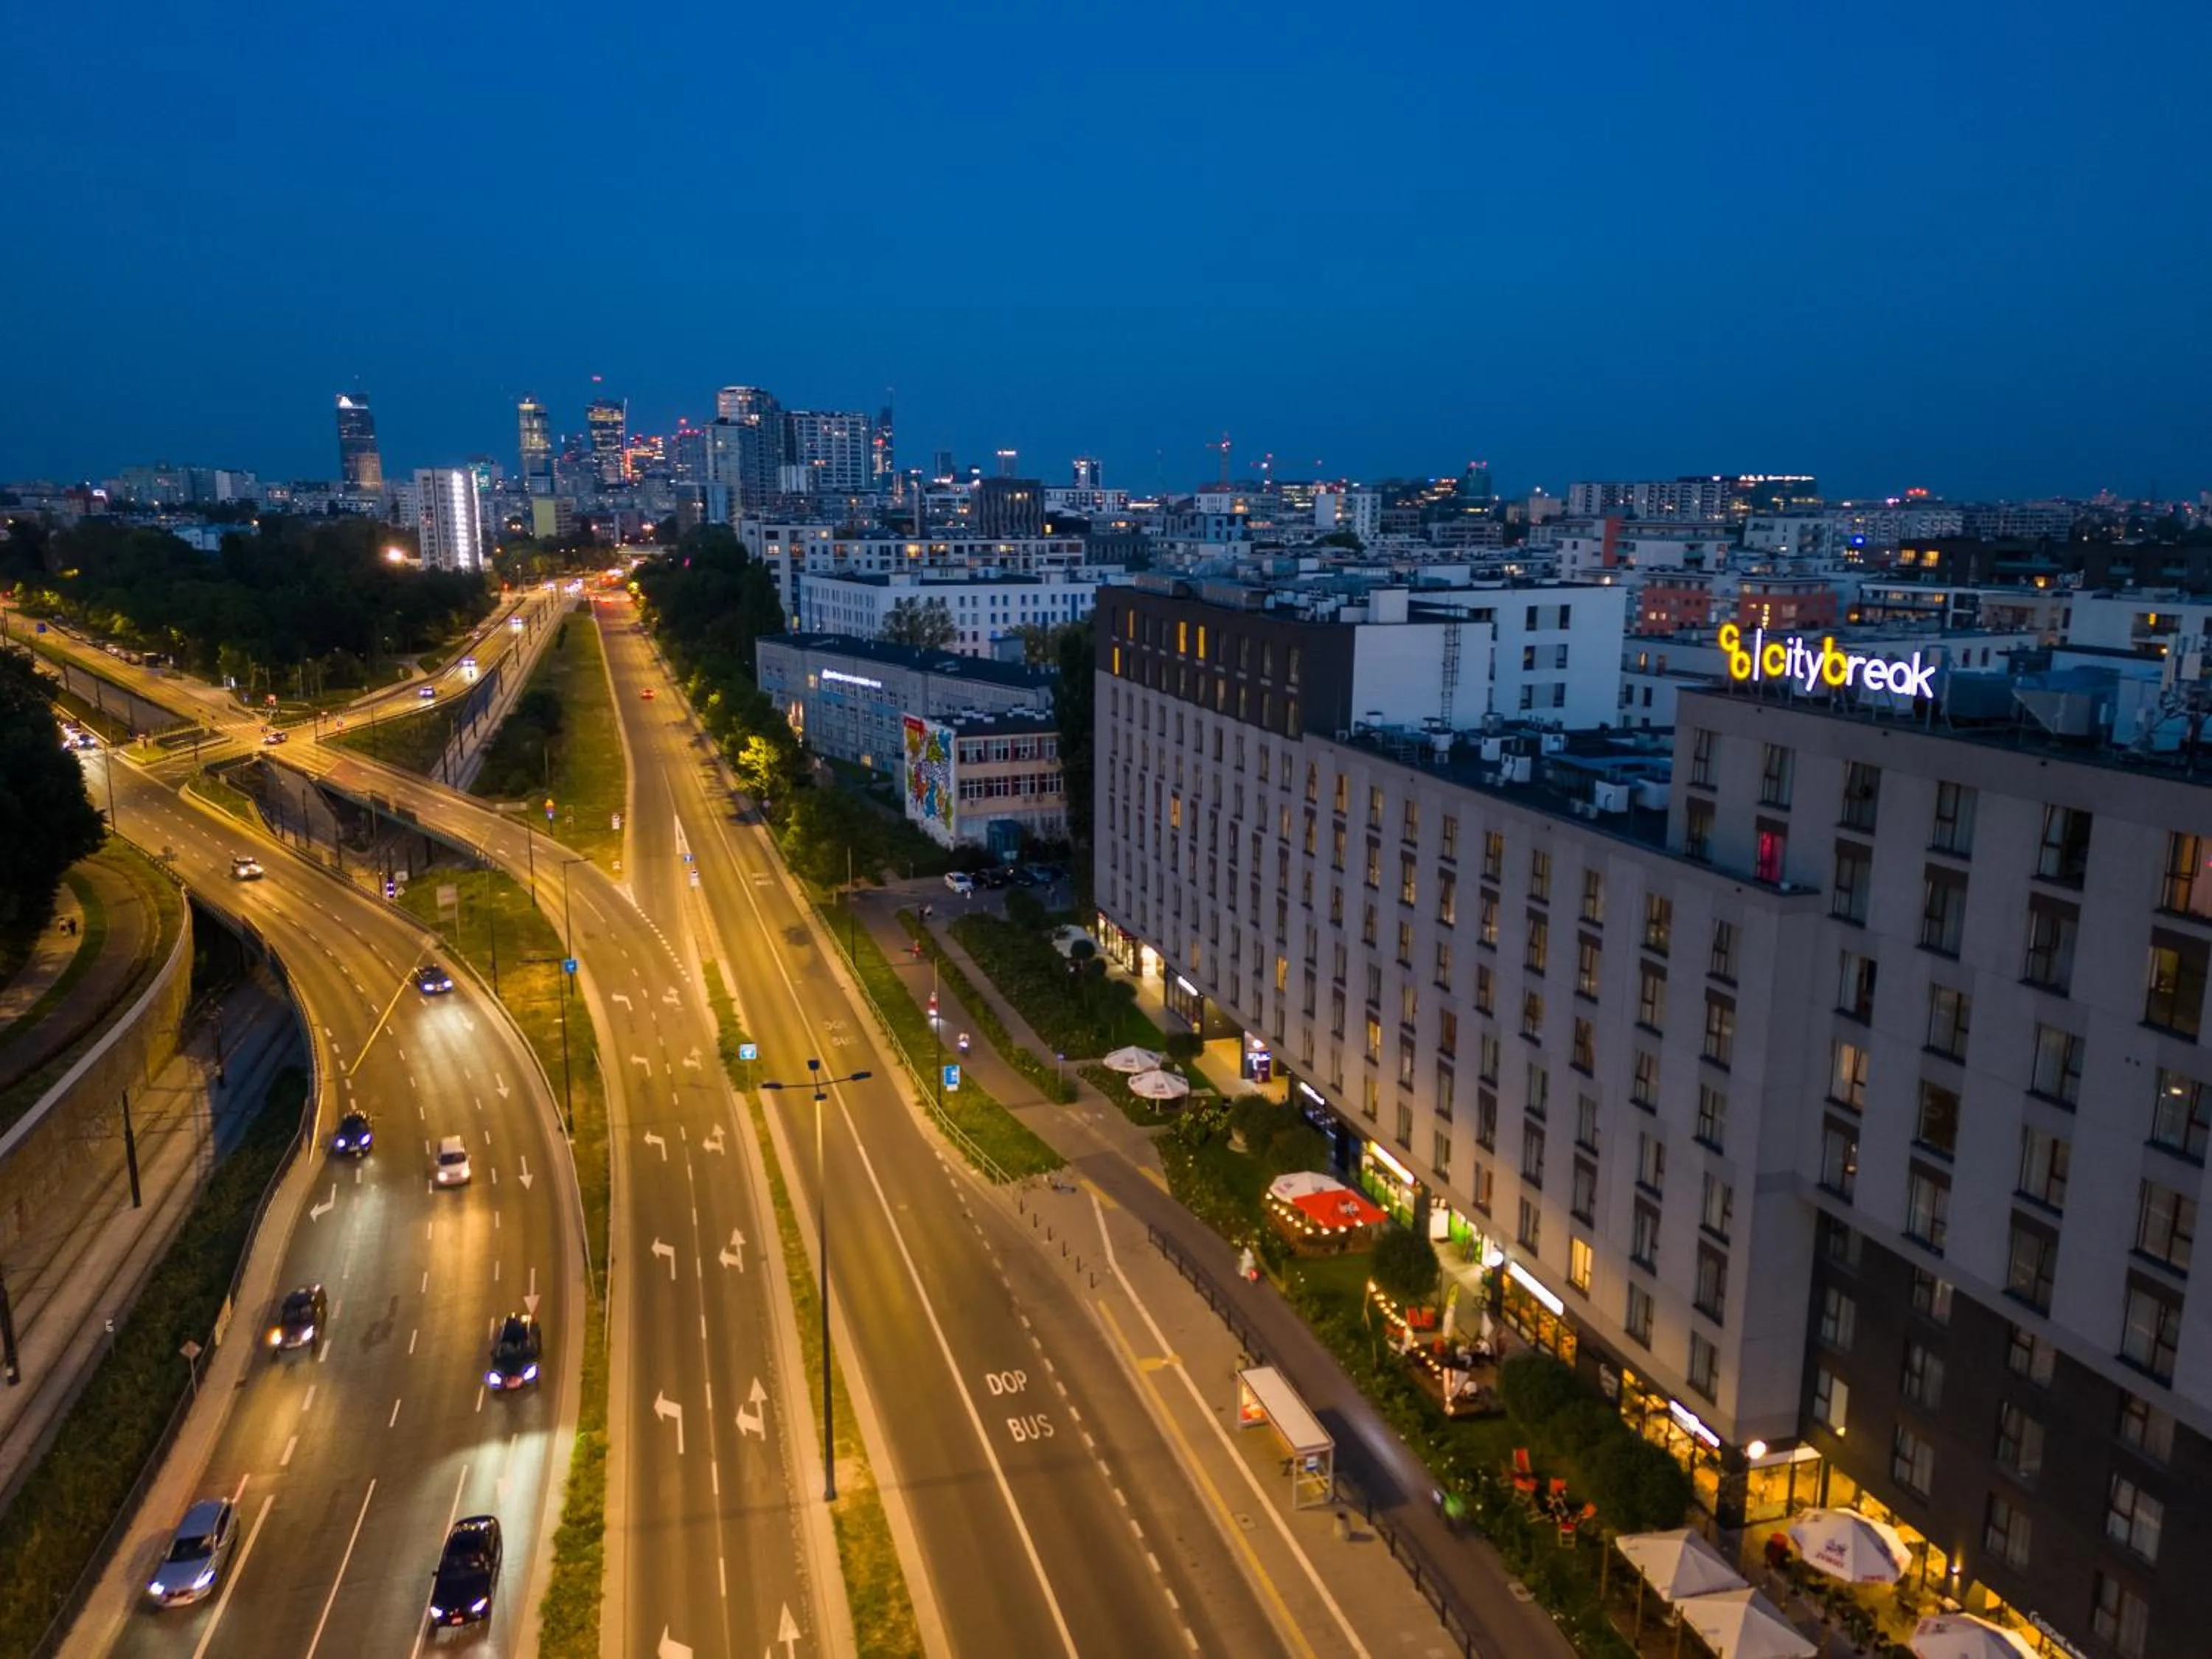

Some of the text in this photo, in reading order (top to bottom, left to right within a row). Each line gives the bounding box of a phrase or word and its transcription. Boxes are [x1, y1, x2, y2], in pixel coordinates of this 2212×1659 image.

[1763, 636, 1935, 698] citybreak
[986, 1369, 1027, 1395] DOP
[1006, 1413, 1054, 1442] BUS
